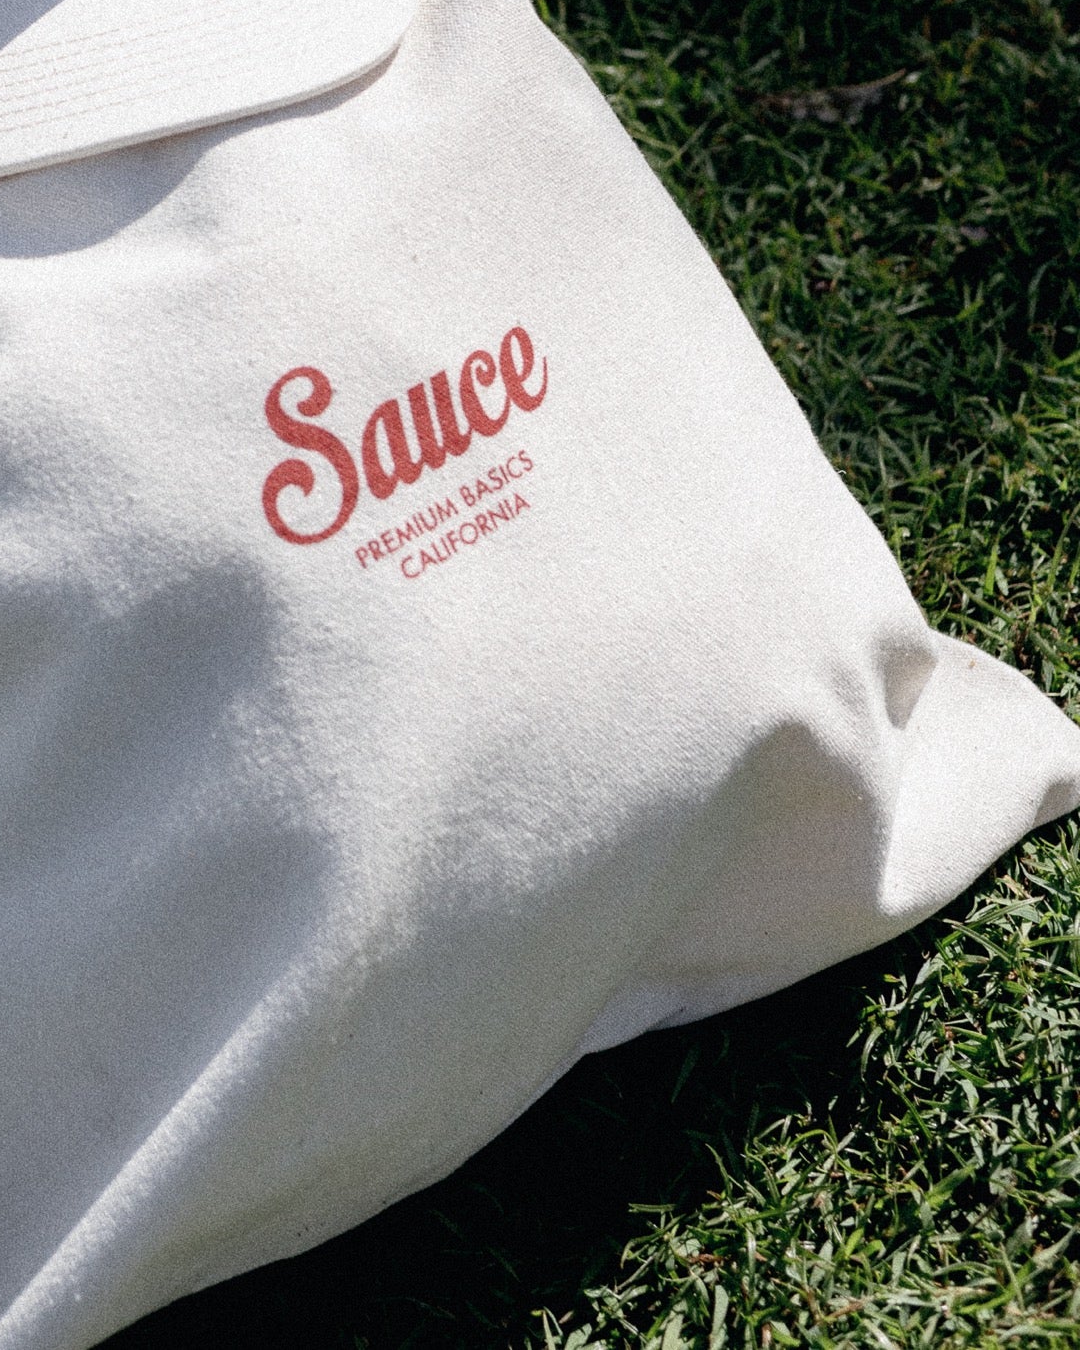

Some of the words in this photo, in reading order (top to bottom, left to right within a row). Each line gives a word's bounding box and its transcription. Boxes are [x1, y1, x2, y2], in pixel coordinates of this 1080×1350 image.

[261, 326, 549, 546] Sauce
[355, 497, 459, 569] PREMIUM
[459, 449, 534, 508] BASICS
[400, 492, 531, 579] CALIFORNIA
